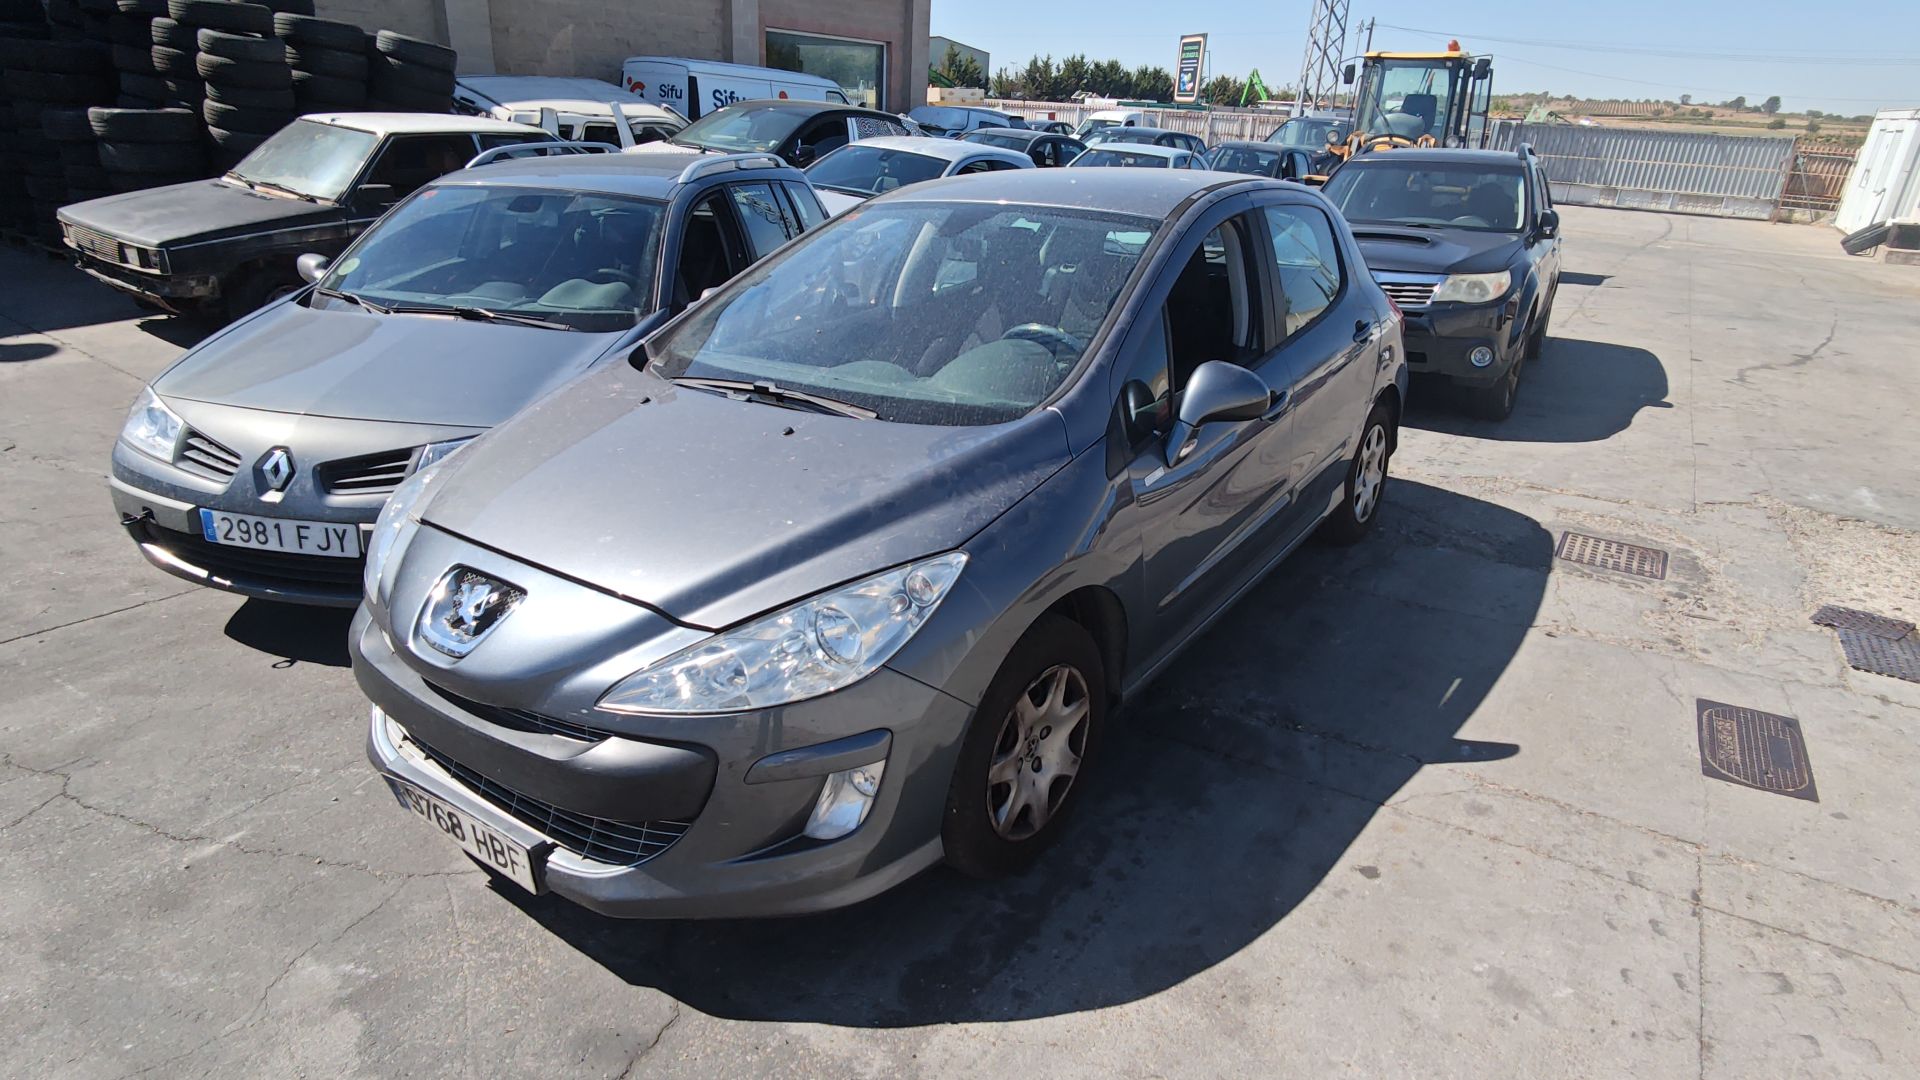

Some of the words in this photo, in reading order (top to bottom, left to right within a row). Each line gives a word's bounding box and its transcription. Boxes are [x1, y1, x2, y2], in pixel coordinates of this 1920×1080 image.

[659, 84, 683, 99] Sifu
[220, 516, 284, 548] 2981
[296, 524, 348, 553] FJY
[404, 787, 466, 842] 9768
[471, 824, 520, 876] HBF
